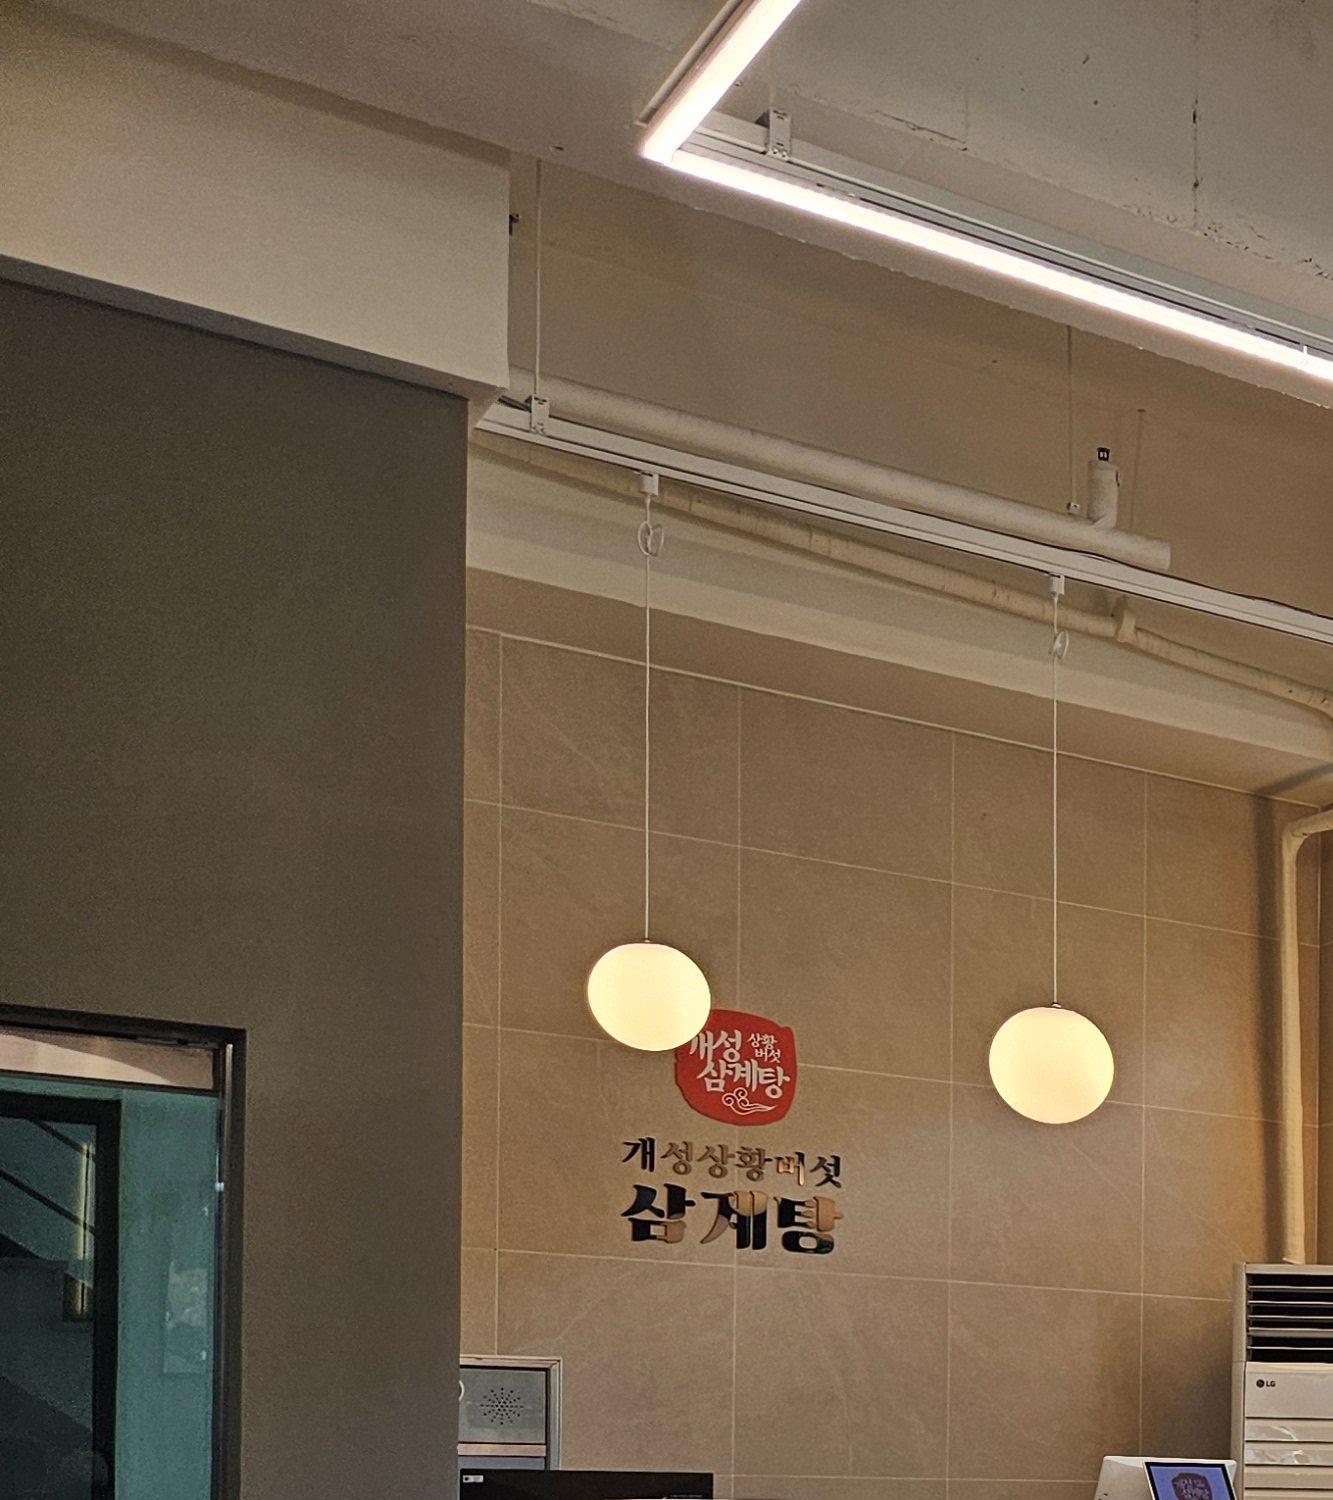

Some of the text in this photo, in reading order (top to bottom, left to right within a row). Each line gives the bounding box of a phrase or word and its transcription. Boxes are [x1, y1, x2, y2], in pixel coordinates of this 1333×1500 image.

[689, 1029, 742, 1064] 개성
[747, 1033, 778, 1050] 상황
[754, 1048, 781, 1063] 버섯
[697, 1059, 791, 1099] 삼계탕
[621, 1137, 842, 1189] 개성상황버섯
[621, 1183, 845, 1255] 삼계탕
[1265, 1380, 1276, 1388] LG
